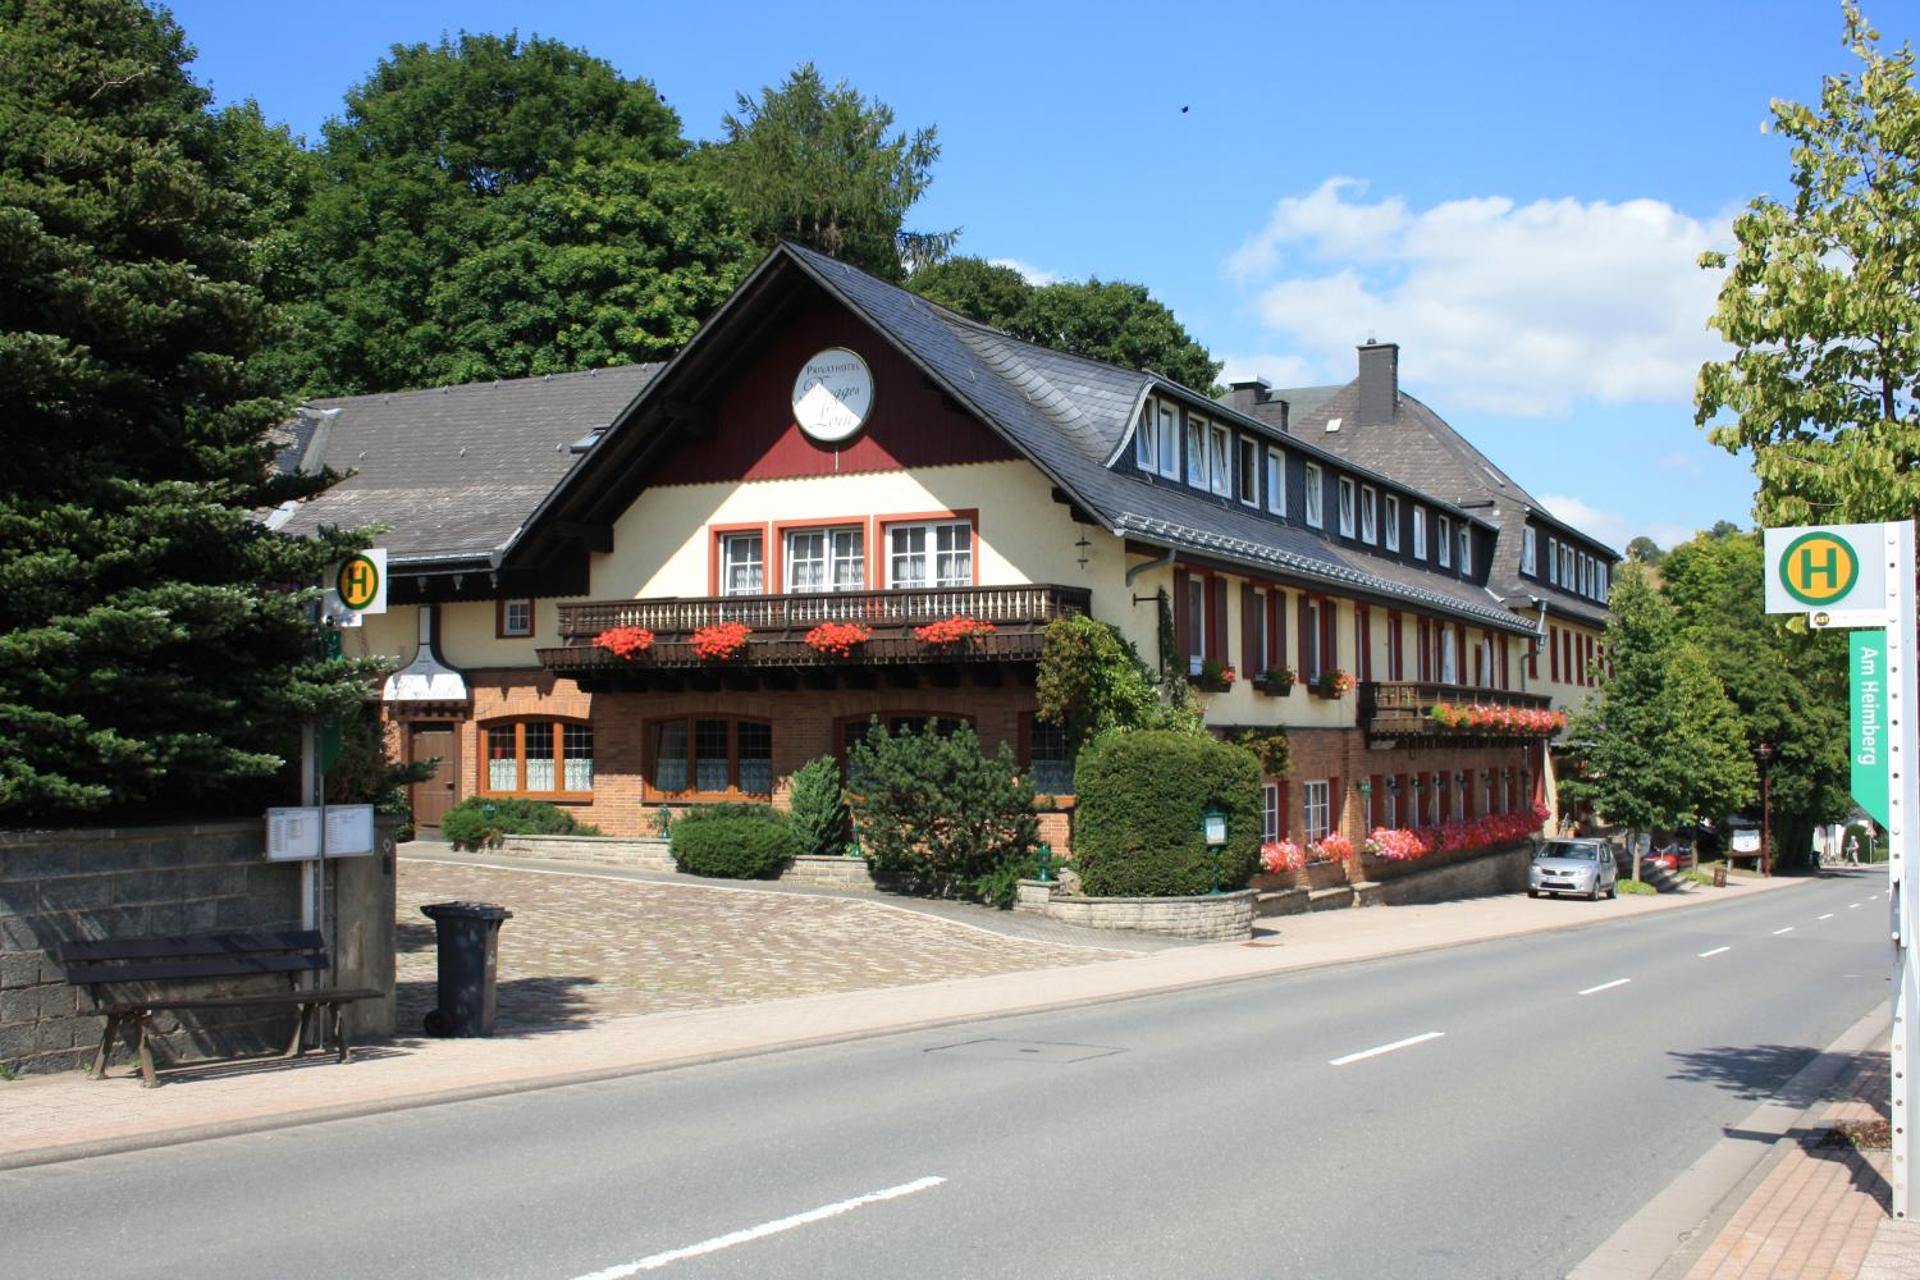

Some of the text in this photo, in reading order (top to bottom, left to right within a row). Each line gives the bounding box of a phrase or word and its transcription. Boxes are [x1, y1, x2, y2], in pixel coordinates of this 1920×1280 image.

[347, 567, 367, 597] H
[1801, 549, 1837, 588] H
[1857, 646, 1880, 765] Am Heimberg
